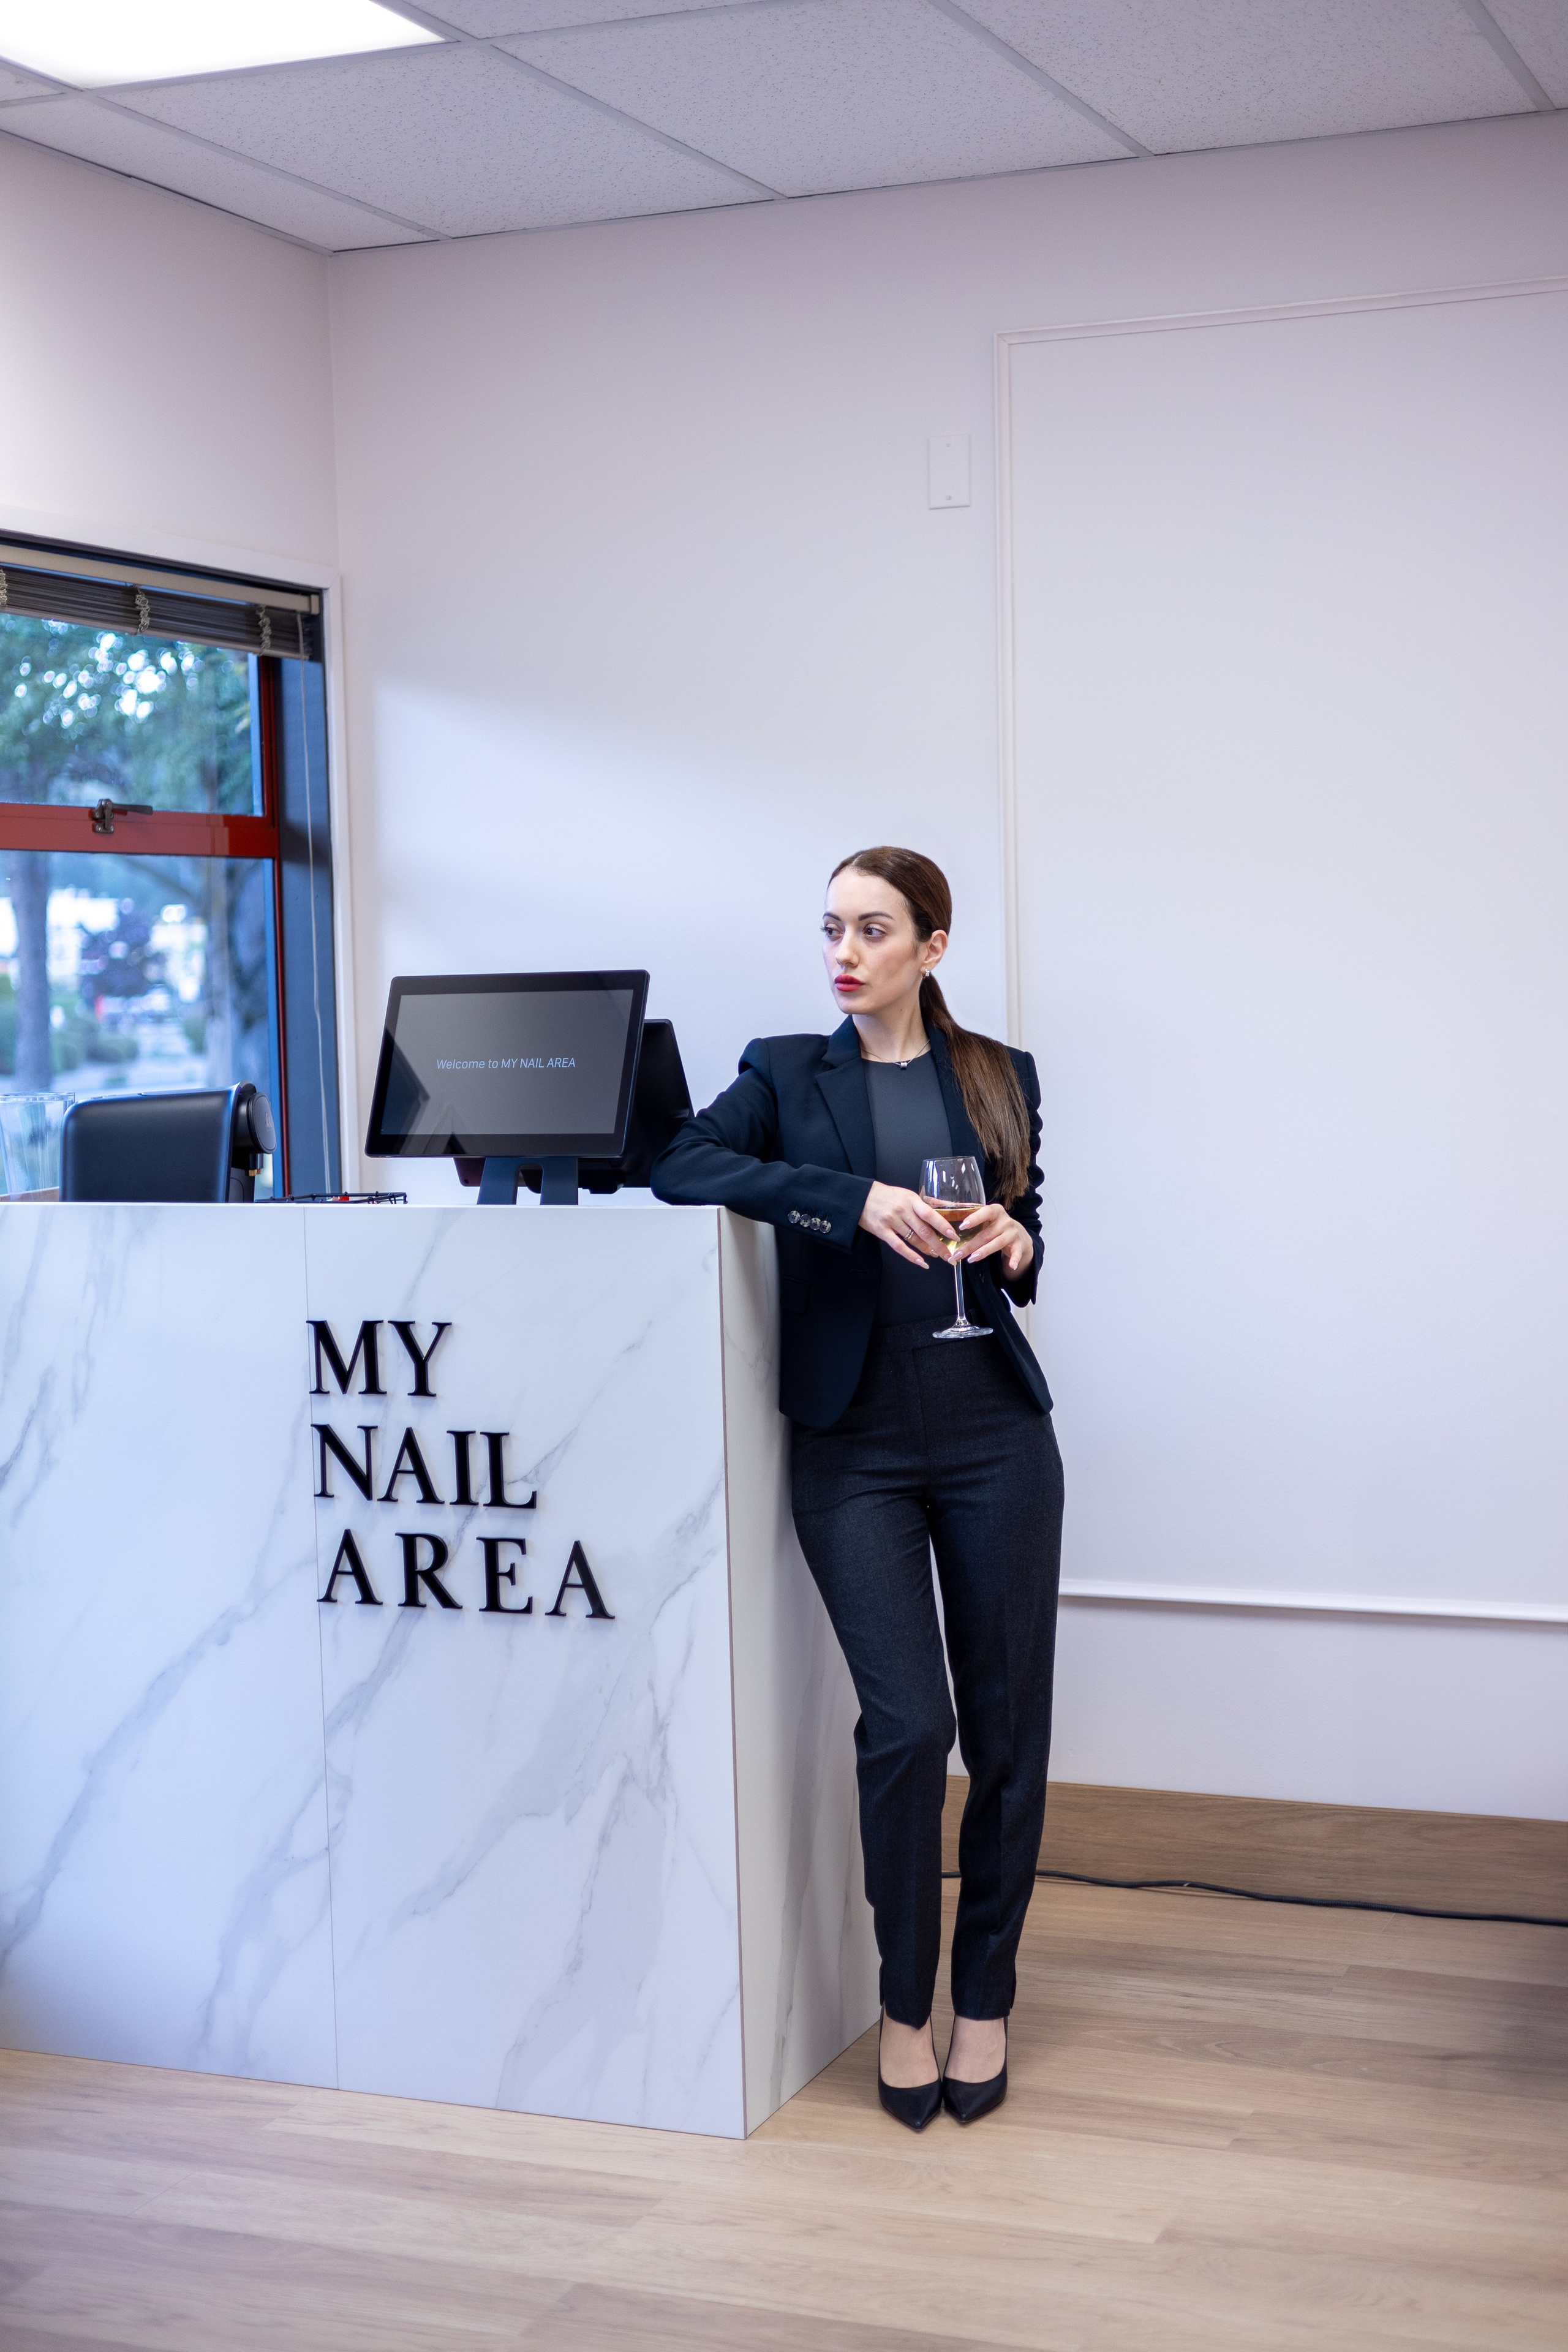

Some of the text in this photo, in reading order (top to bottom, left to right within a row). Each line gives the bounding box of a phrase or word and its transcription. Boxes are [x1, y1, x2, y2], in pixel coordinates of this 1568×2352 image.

[437, 1057, 576, 1069] Welcome to MY NAIL AREA
[306, 1319, 452, 1397] MY
[311, 1423, 537, 1509] NAIL
[316, 1528, 615, 1619] AREA
